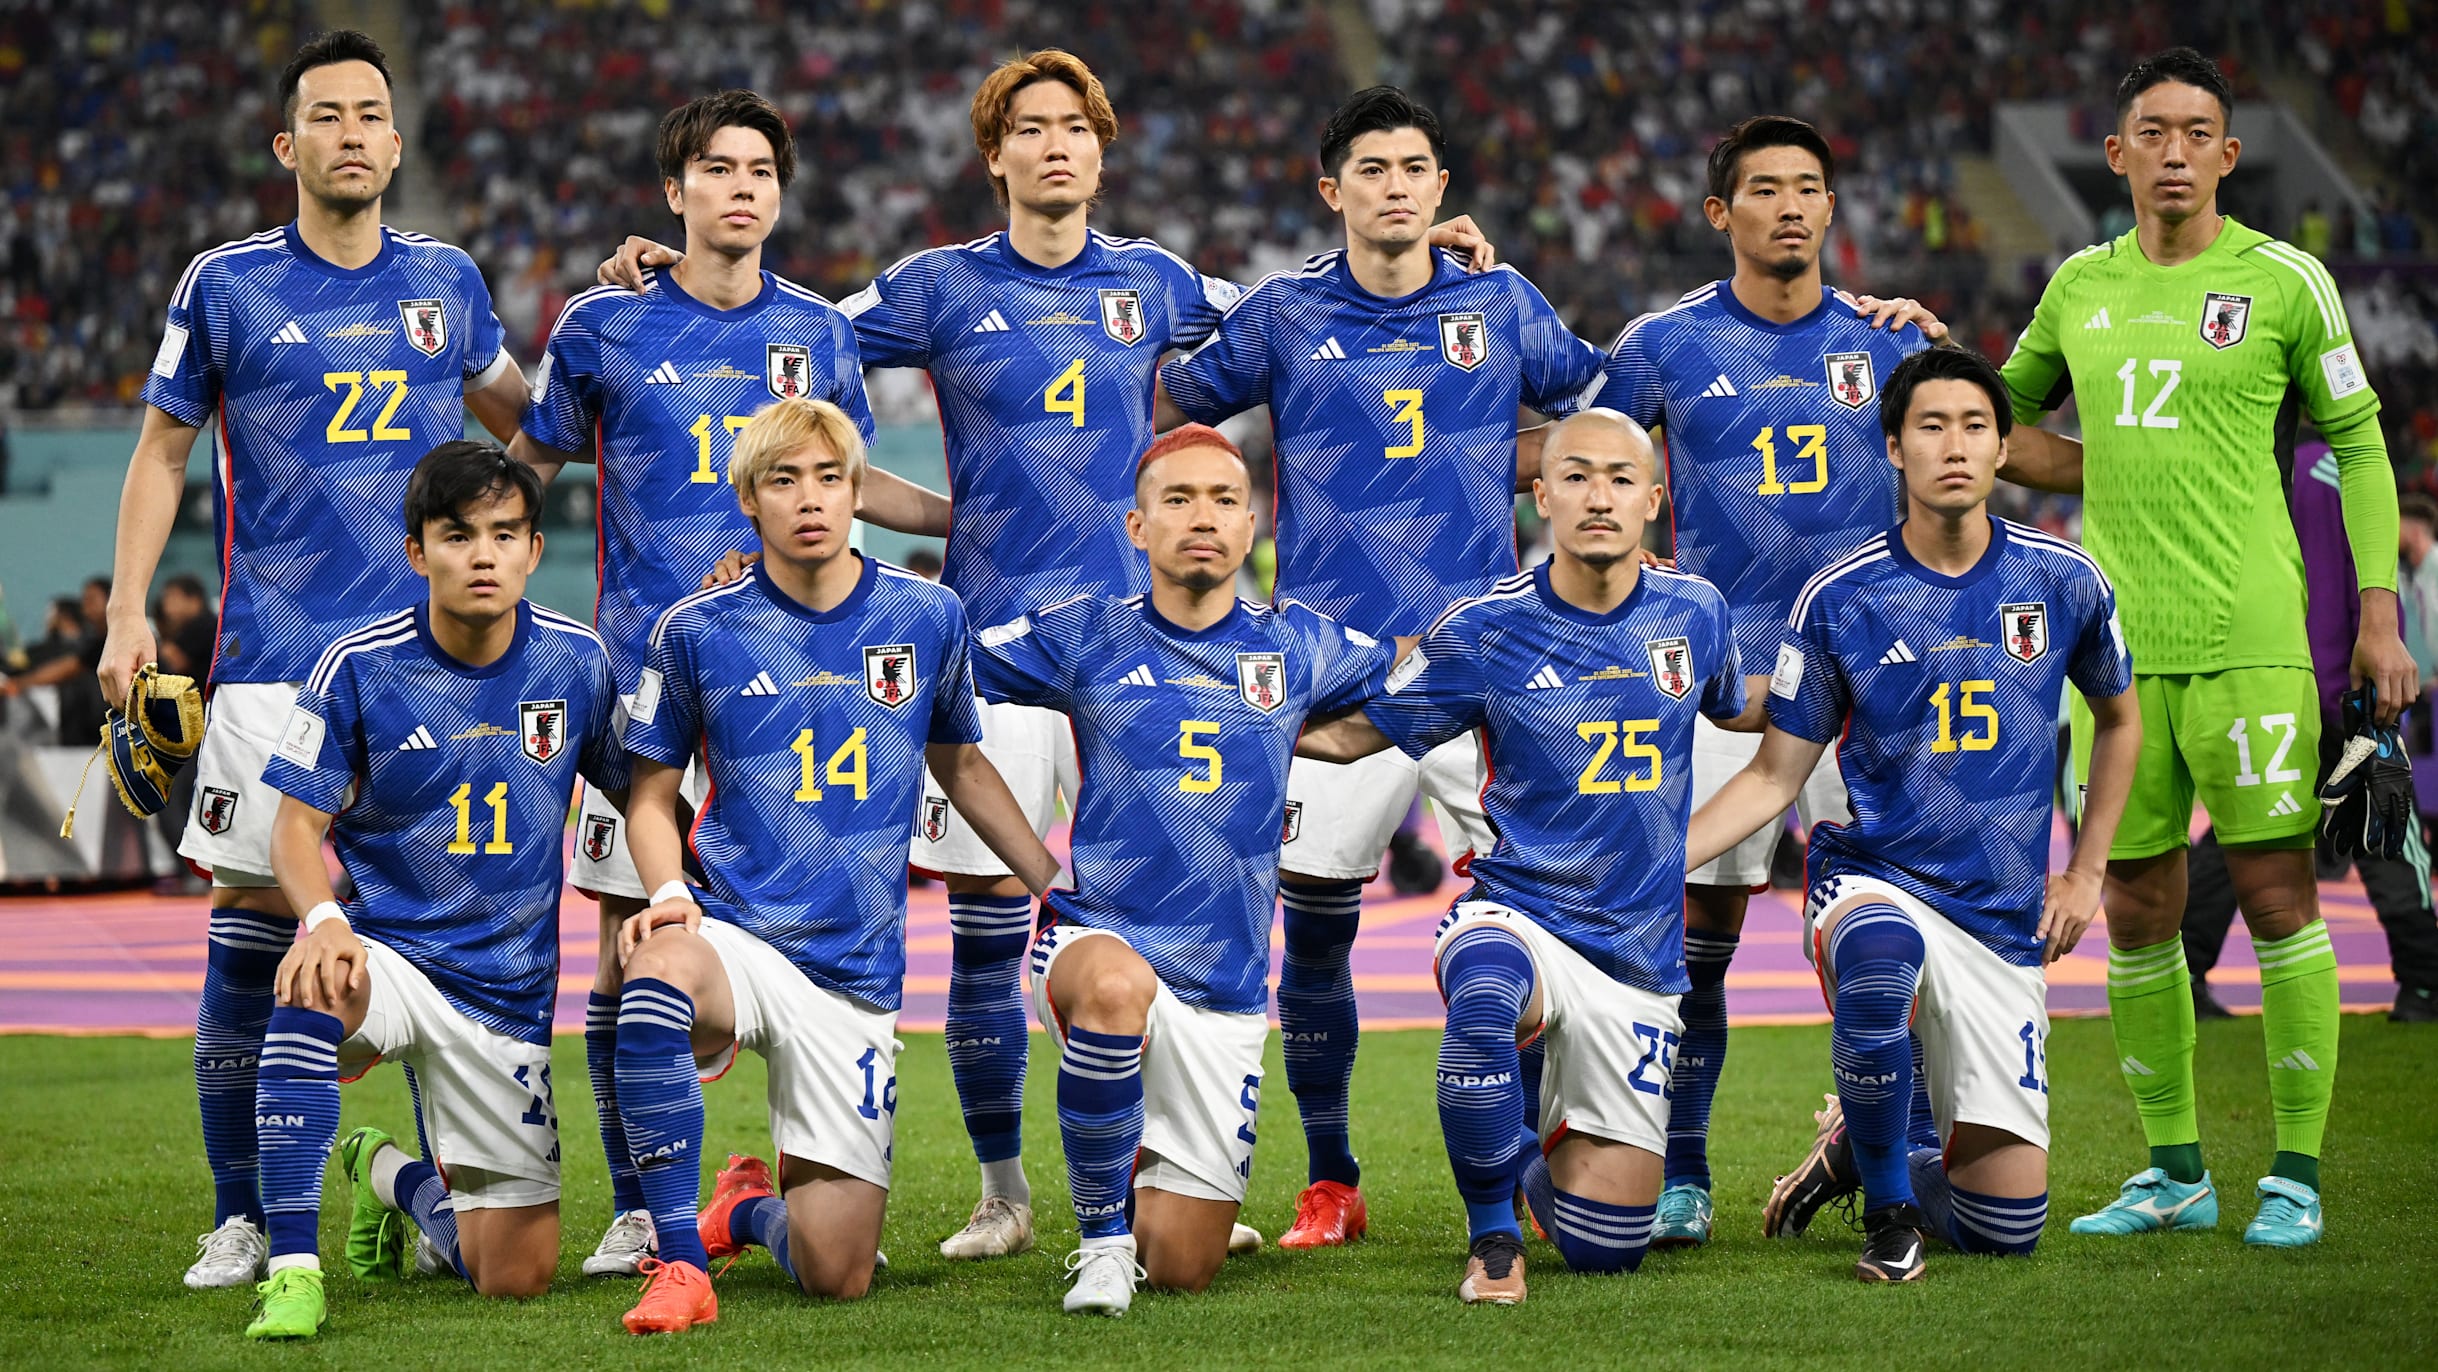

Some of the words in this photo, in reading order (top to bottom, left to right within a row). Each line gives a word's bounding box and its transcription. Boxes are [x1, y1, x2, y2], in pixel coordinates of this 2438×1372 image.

[2217, 294, 2241, 302] JAPAN
[1119, 327, 1136, 336] JFA
[2210, 330, 2230, 341] JFA
[421, 337, 438, 346] JFA
[1458, 352, 1477, 361] JFA
[781, 385, 799, 394] JFA
[1045, 359, 1085, 426] 4
[2115, 357, 2183, 429] 12
[1844, 391, 1863, 401] JFA
[325, 371, 409, 441] 22
[1384, 389, 1425, 458] 3
[1753, 425, 1828, 495] 13
[1657, 640, 1679, 648] JAPAN
[2017, 644, 2036, 654] JFA
[876, 647, 902, 655] JAPAN
[1669, 679, 1685, 690] JFA
[881, 688, 903, 699] JFA
[1256, 694, 1275, 703] JFA
[1930, 680, 1999, 753] 15
[117, 722, 138, 738] Jaa
[534, 744, 553, 754] JFA
[2227, 713, 2302, 787] 12
[1180, 721, 1222, 793] 5
[1578, 719, 1663, 793] 25
[791, 728, 867, 801] 14
[211, 788, 231, 796] JAPAN
[447, 782, 513, 854] 11
[1282, 1031, 1328, 1042] PAN
[945, 1037, 1000, 1049] PAN
[202, 1055, 260, 1070] JAP
[1437, 1072, 1512, 1087] JAPAN
[1833, 1066, 1897, 1086] APAN
[255, 1114, 305, 1128] PAN
